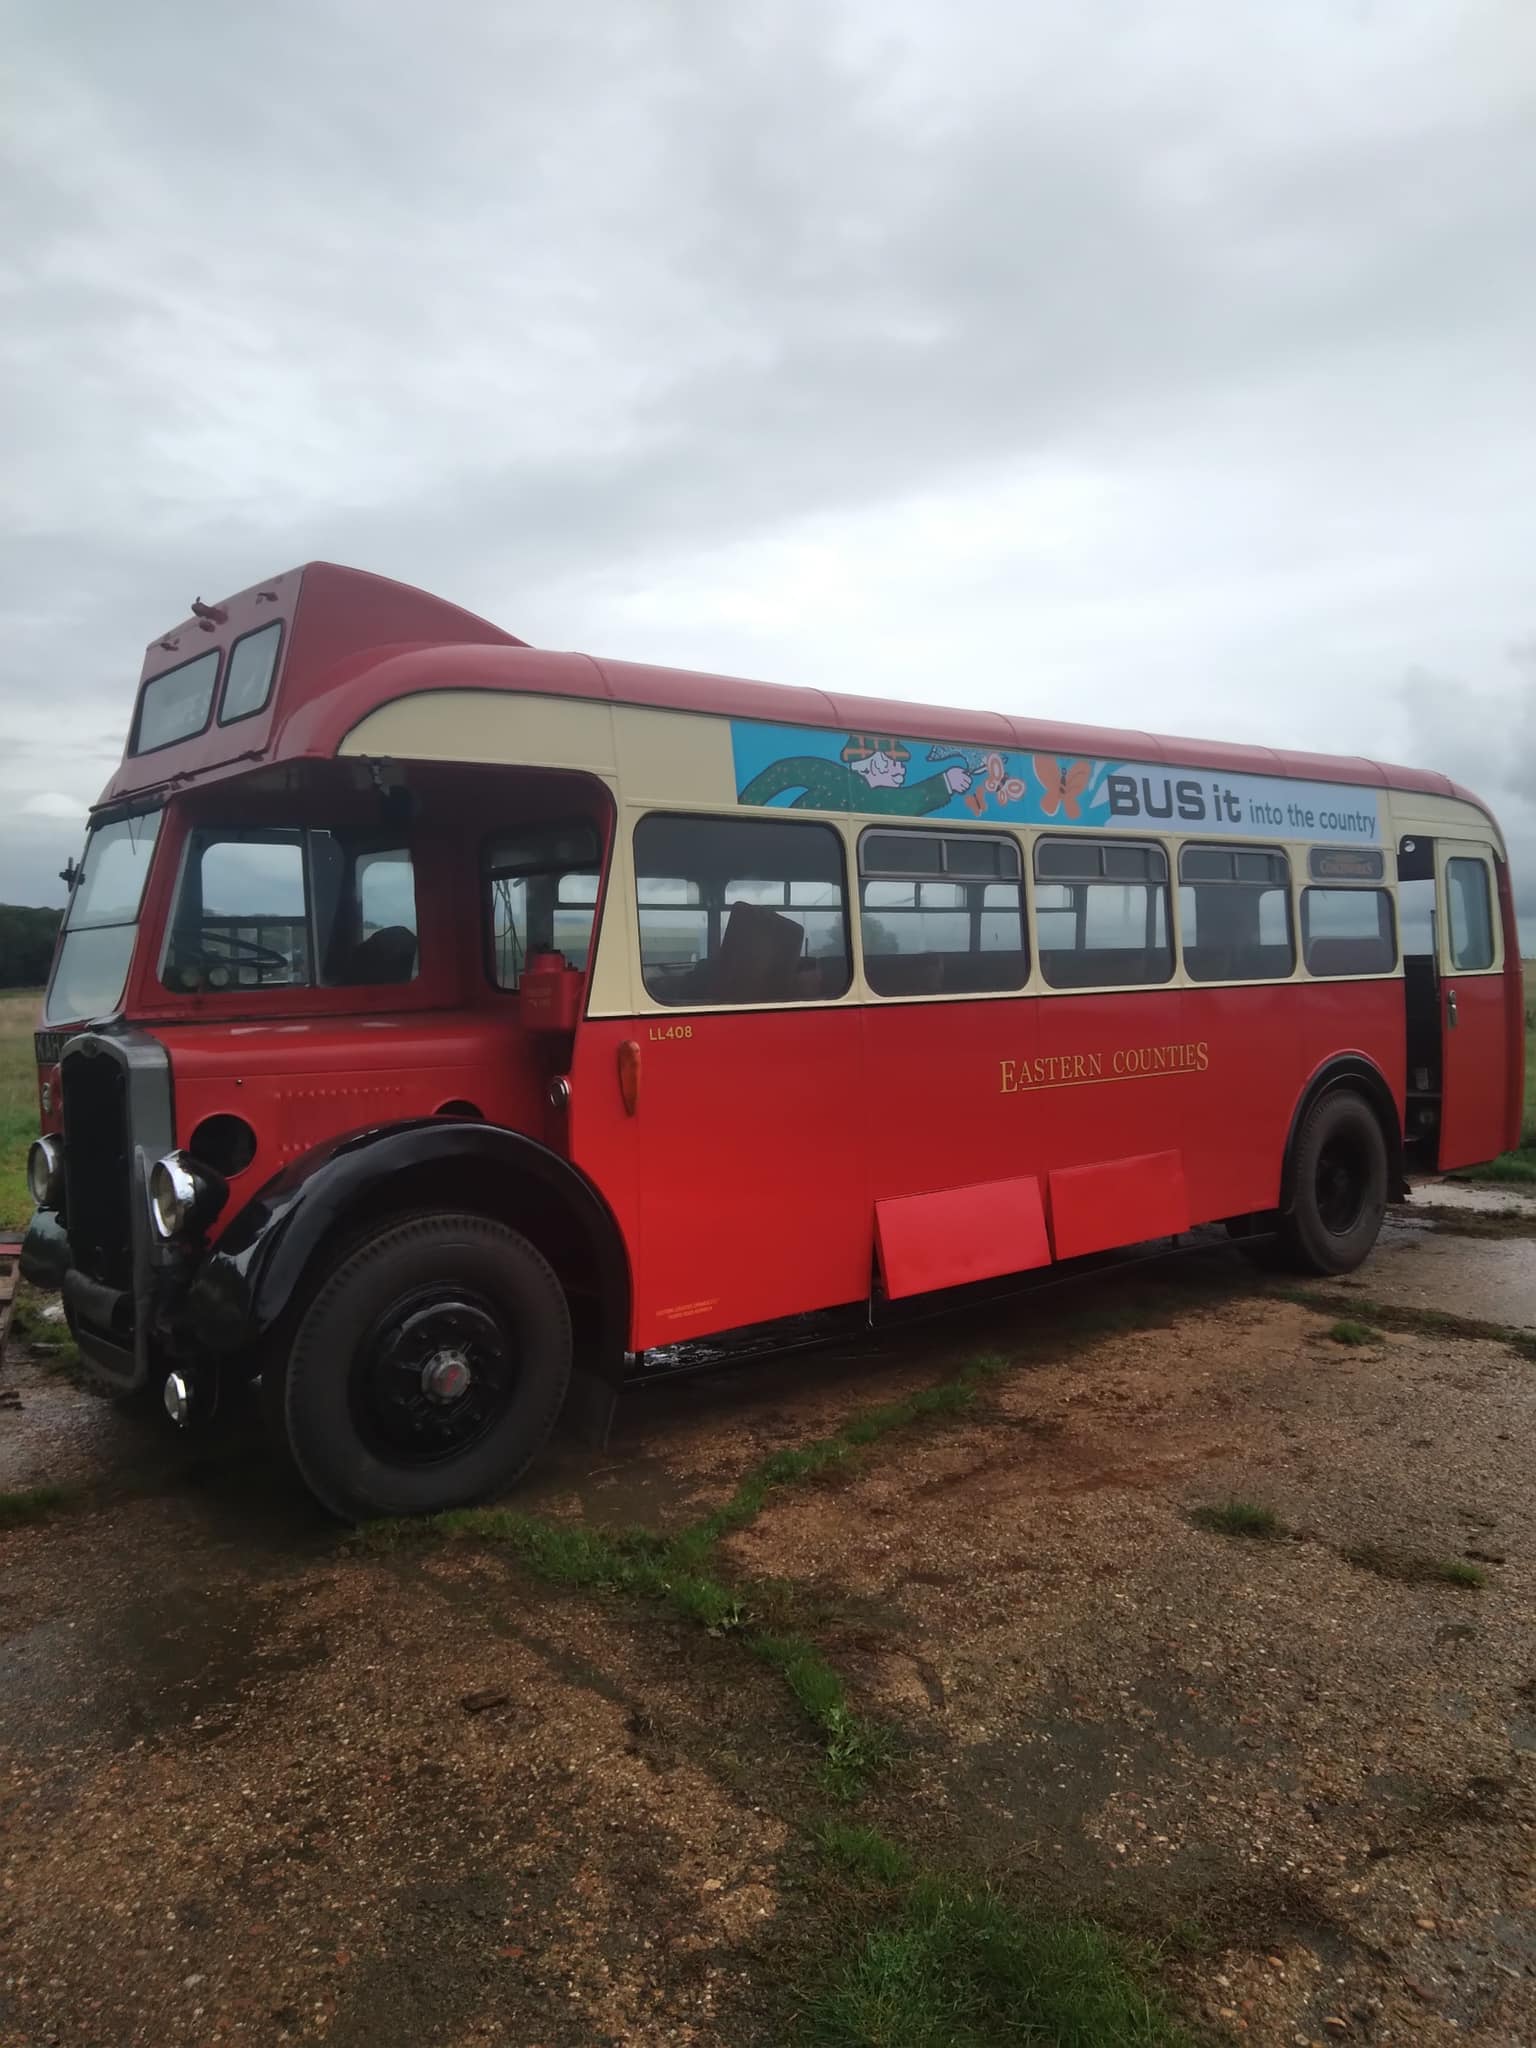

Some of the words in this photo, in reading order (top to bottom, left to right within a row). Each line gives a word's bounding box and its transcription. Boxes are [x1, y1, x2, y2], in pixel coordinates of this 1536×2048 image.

[1107, 775, 1206, 821] BUS
[1213, 783, 1242, 823] it
[1250, 799, 1283, 825] into
[1288, 804, 1315, 828] the
[1319, 811, 1376, 838] country
[649, 1025, 693, 1041] LL408
[1000, 1053, 1104, 1093] EASTERN
[1113, 1041, 1209, 1073] COUNTIES
